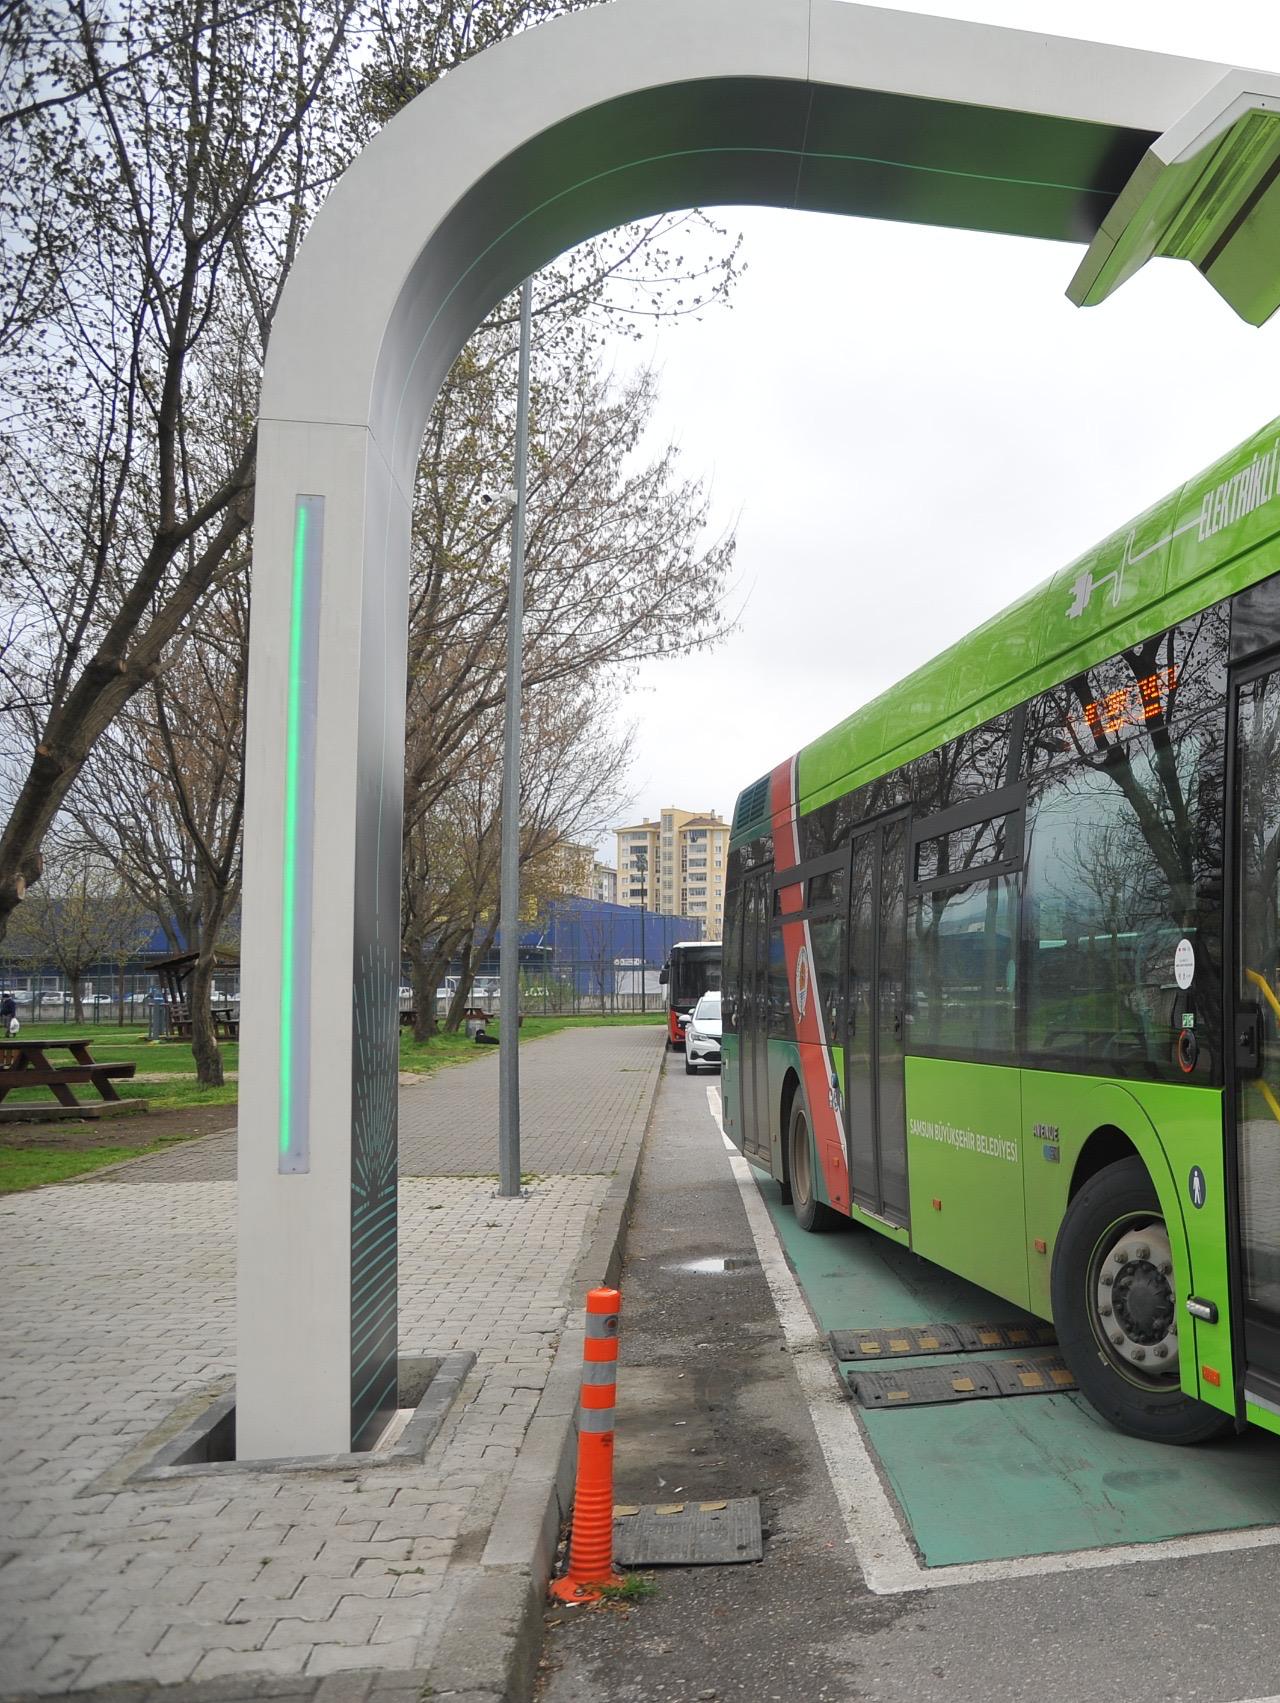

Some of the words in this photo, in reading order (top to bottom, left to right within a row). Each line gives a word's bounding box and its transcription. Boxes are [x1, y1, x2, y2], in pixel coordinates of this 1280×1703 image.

[1198, 437, 1280, 543] ELEKTRİKLİ
[909, 1118, 934, 1140] SAMSUN
[934, 1121, 976, 1151] BÜYÜKŞEHİR
[975, 1134, 1018, 1162] BELEDİYESİ
